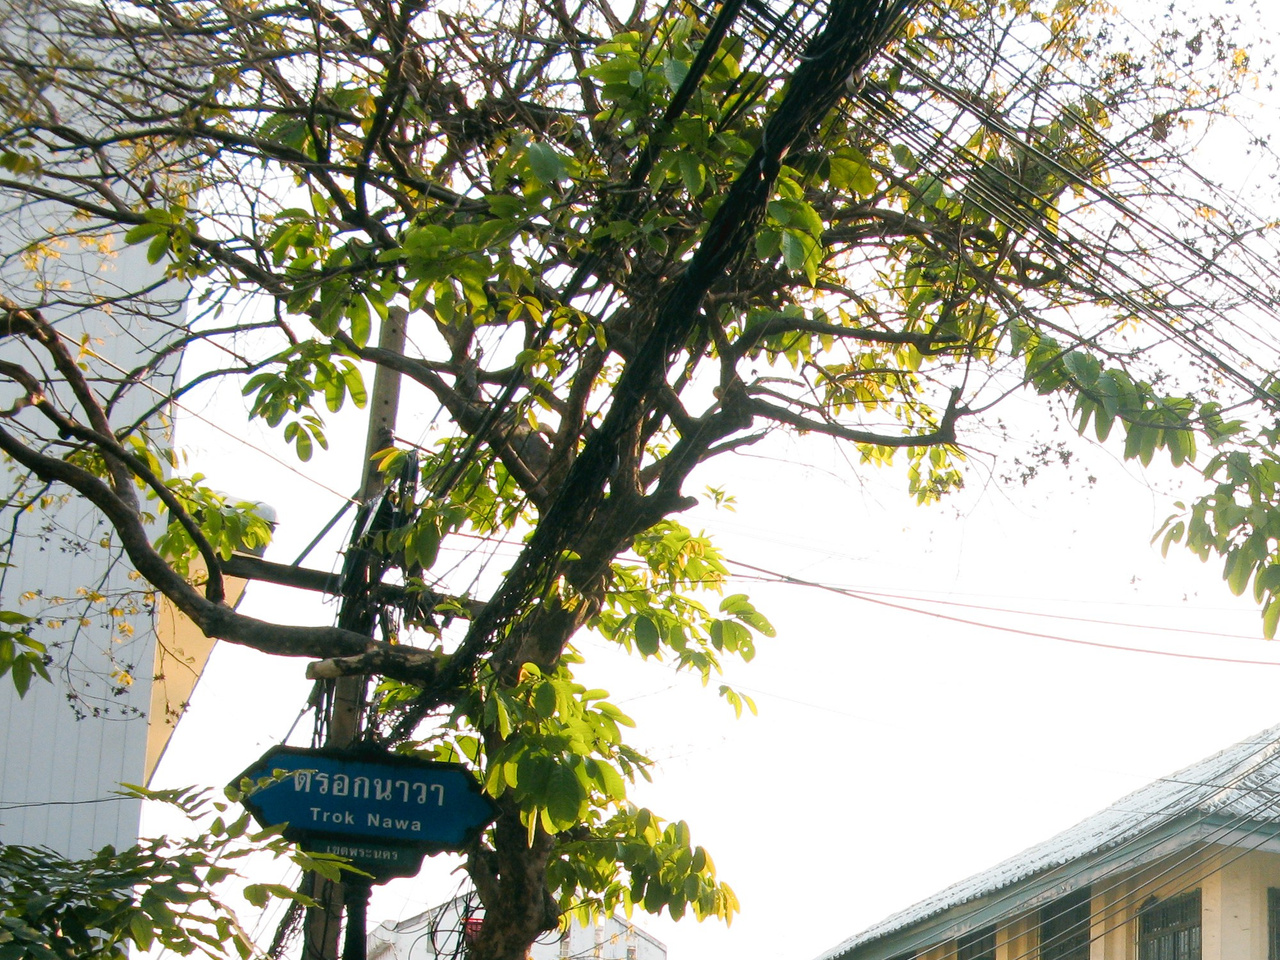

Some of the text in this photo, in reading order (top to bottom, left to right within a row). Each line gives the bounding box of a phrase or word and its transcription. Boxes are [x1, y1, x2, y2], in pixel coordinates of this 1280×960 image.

[294, 770, 445, 806] ตรอกนาวา
[310, 807, 421, 831] Trok Nawa
[327, 845, 399, 860] เขตพระนคร
